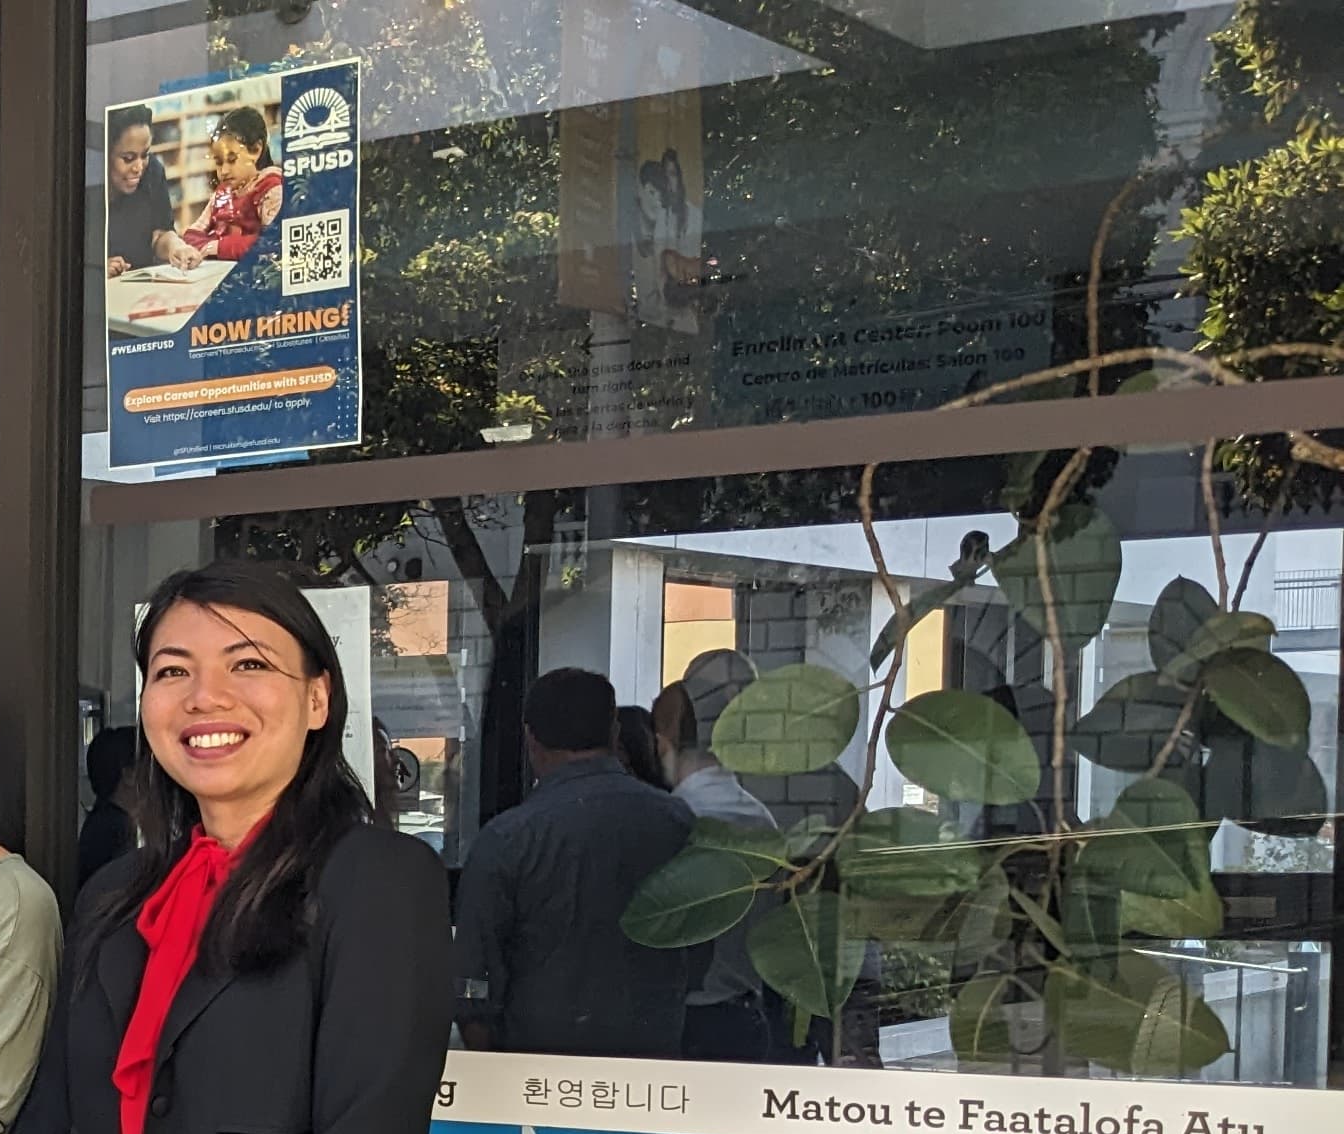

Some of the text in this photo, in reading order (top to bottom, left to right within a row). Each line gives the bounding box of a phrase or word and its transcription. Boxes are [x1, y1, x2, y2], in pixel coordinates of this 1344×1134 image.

[283, 149, 353, 178] SFUSD
[191, 303, 351, 347] NOW HIRING!
[1010, 311, 1046, 328] 100
[111, 339, 175, 356] #WEARESFUSD
[627, 358, 662, 372] doors
[125, 372, 332, 407] Explore Career Opportunities with SFUSD
[143, 413, 161, 424] Visit
[274, 400, 283, 409] to
[285, 397, 312, 410] apply.
[522, 1075, 691, 1116] 환영합니다
[762, 1088, 892, 1128] Matou
[905, 1094, 946, 1130] te
